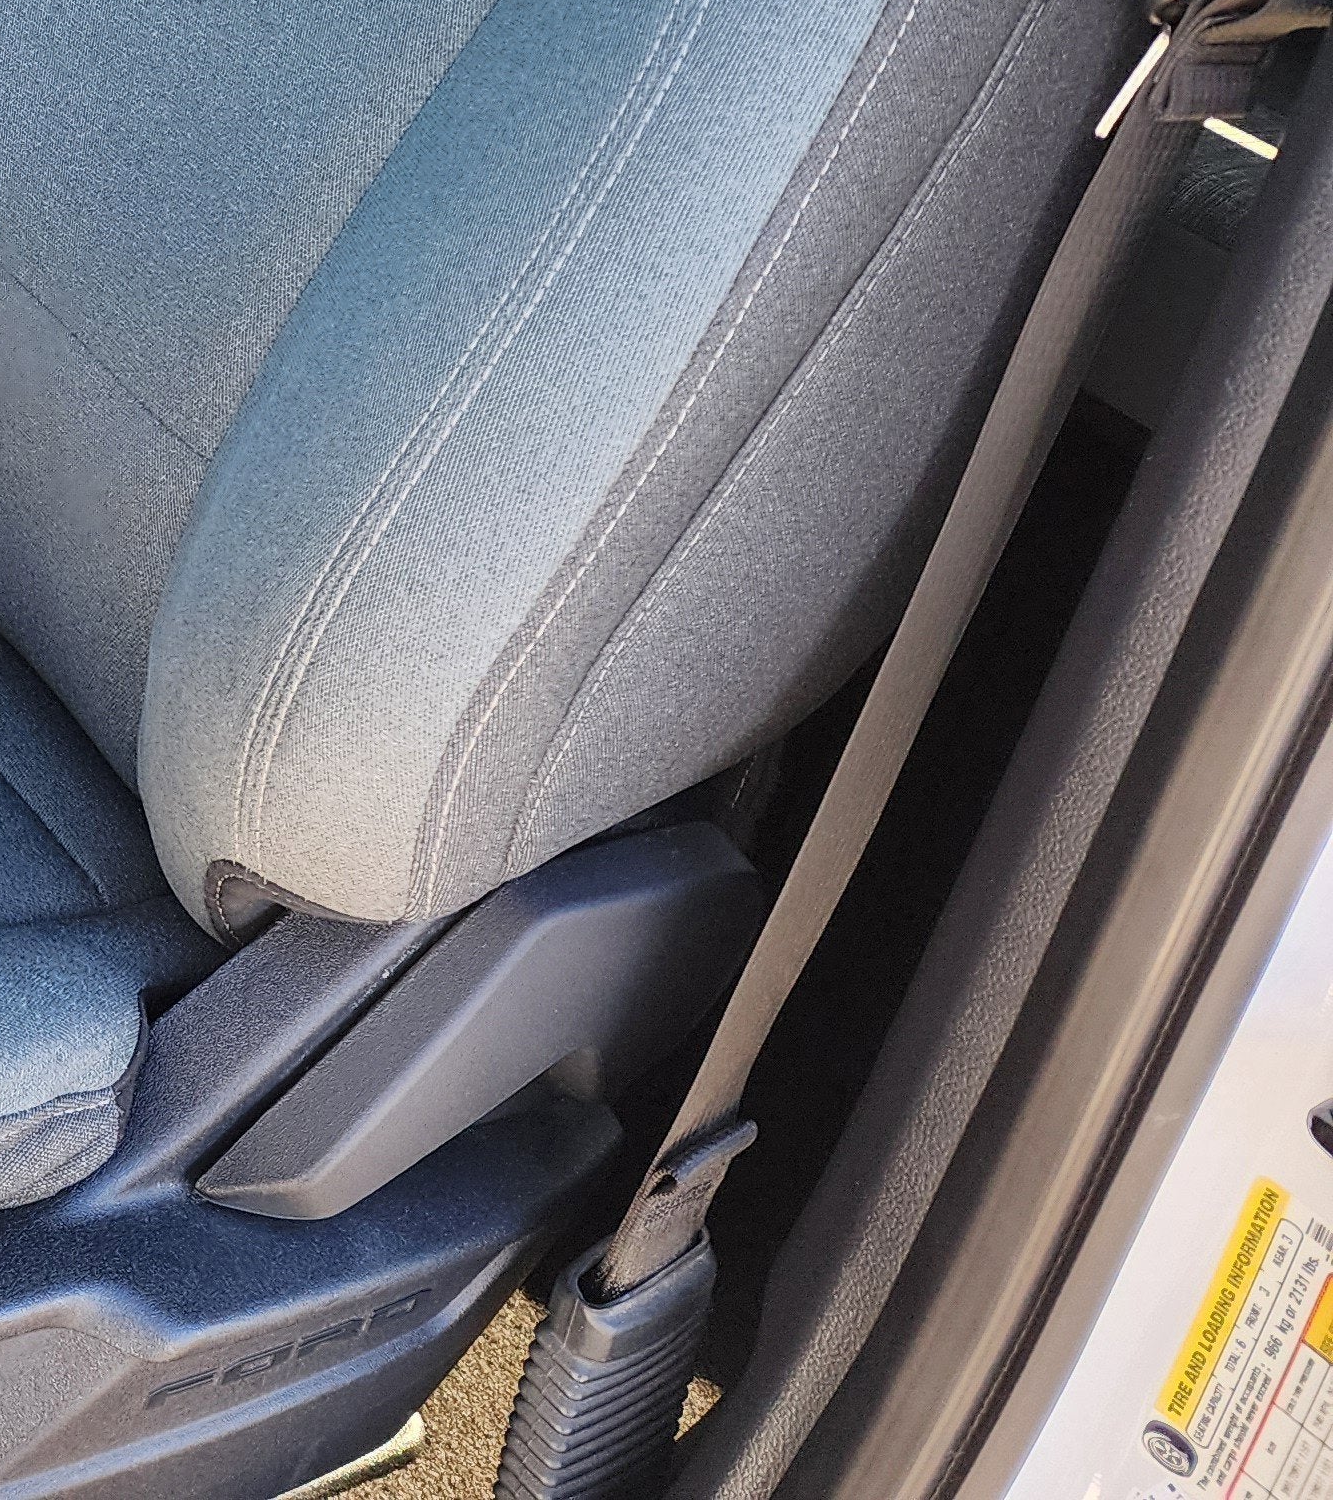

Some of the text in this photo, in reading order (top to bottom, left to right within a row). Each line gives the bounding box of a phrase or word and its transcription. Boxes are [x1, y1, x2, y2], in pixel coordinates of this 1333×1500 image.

[1167, 1187, 1280, 1417] TIRE AND LOADING INFORMATION
[1235, 1338, 1247, 1350] 6
[1281, 1233, 1293, 1246] 3
[1288, 1273, 1311, 1305] 2131
[1275, 1318, 1294, 1335] kg
[1285, 1304, 1297, 1320] or
[1263, 1334, 1283, 1360] 966
